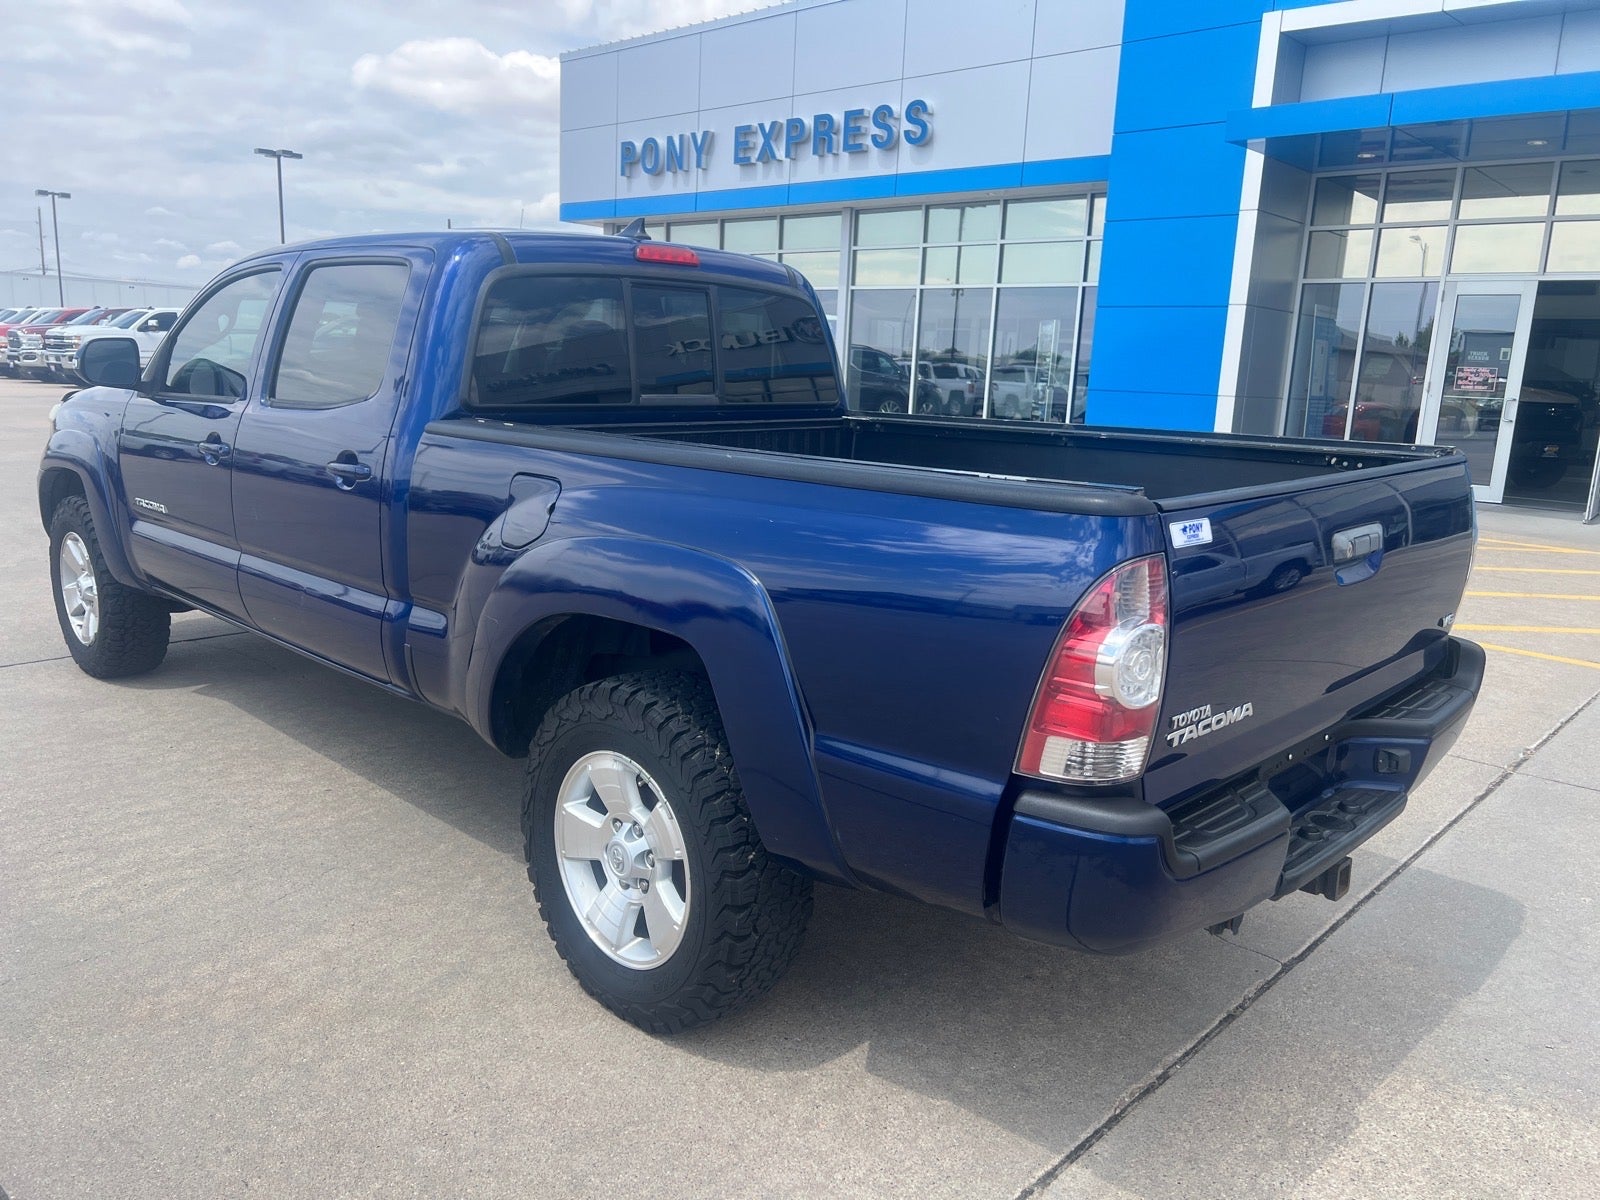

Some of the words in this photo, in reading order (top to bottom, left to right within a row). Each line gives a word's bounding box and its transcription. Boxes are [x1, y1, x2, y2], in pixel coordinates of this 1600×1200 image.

[620, 130, 714, 178] PONY
[733, 99, 934, 166] EXPRESS
[134, 497, 168, 514] TACOMA
[1188, 522, 1202, 533] PONY
[1166, 702, 1253, 747] TACOMA
[1171, 704, 1211, 730] TOYOTA
